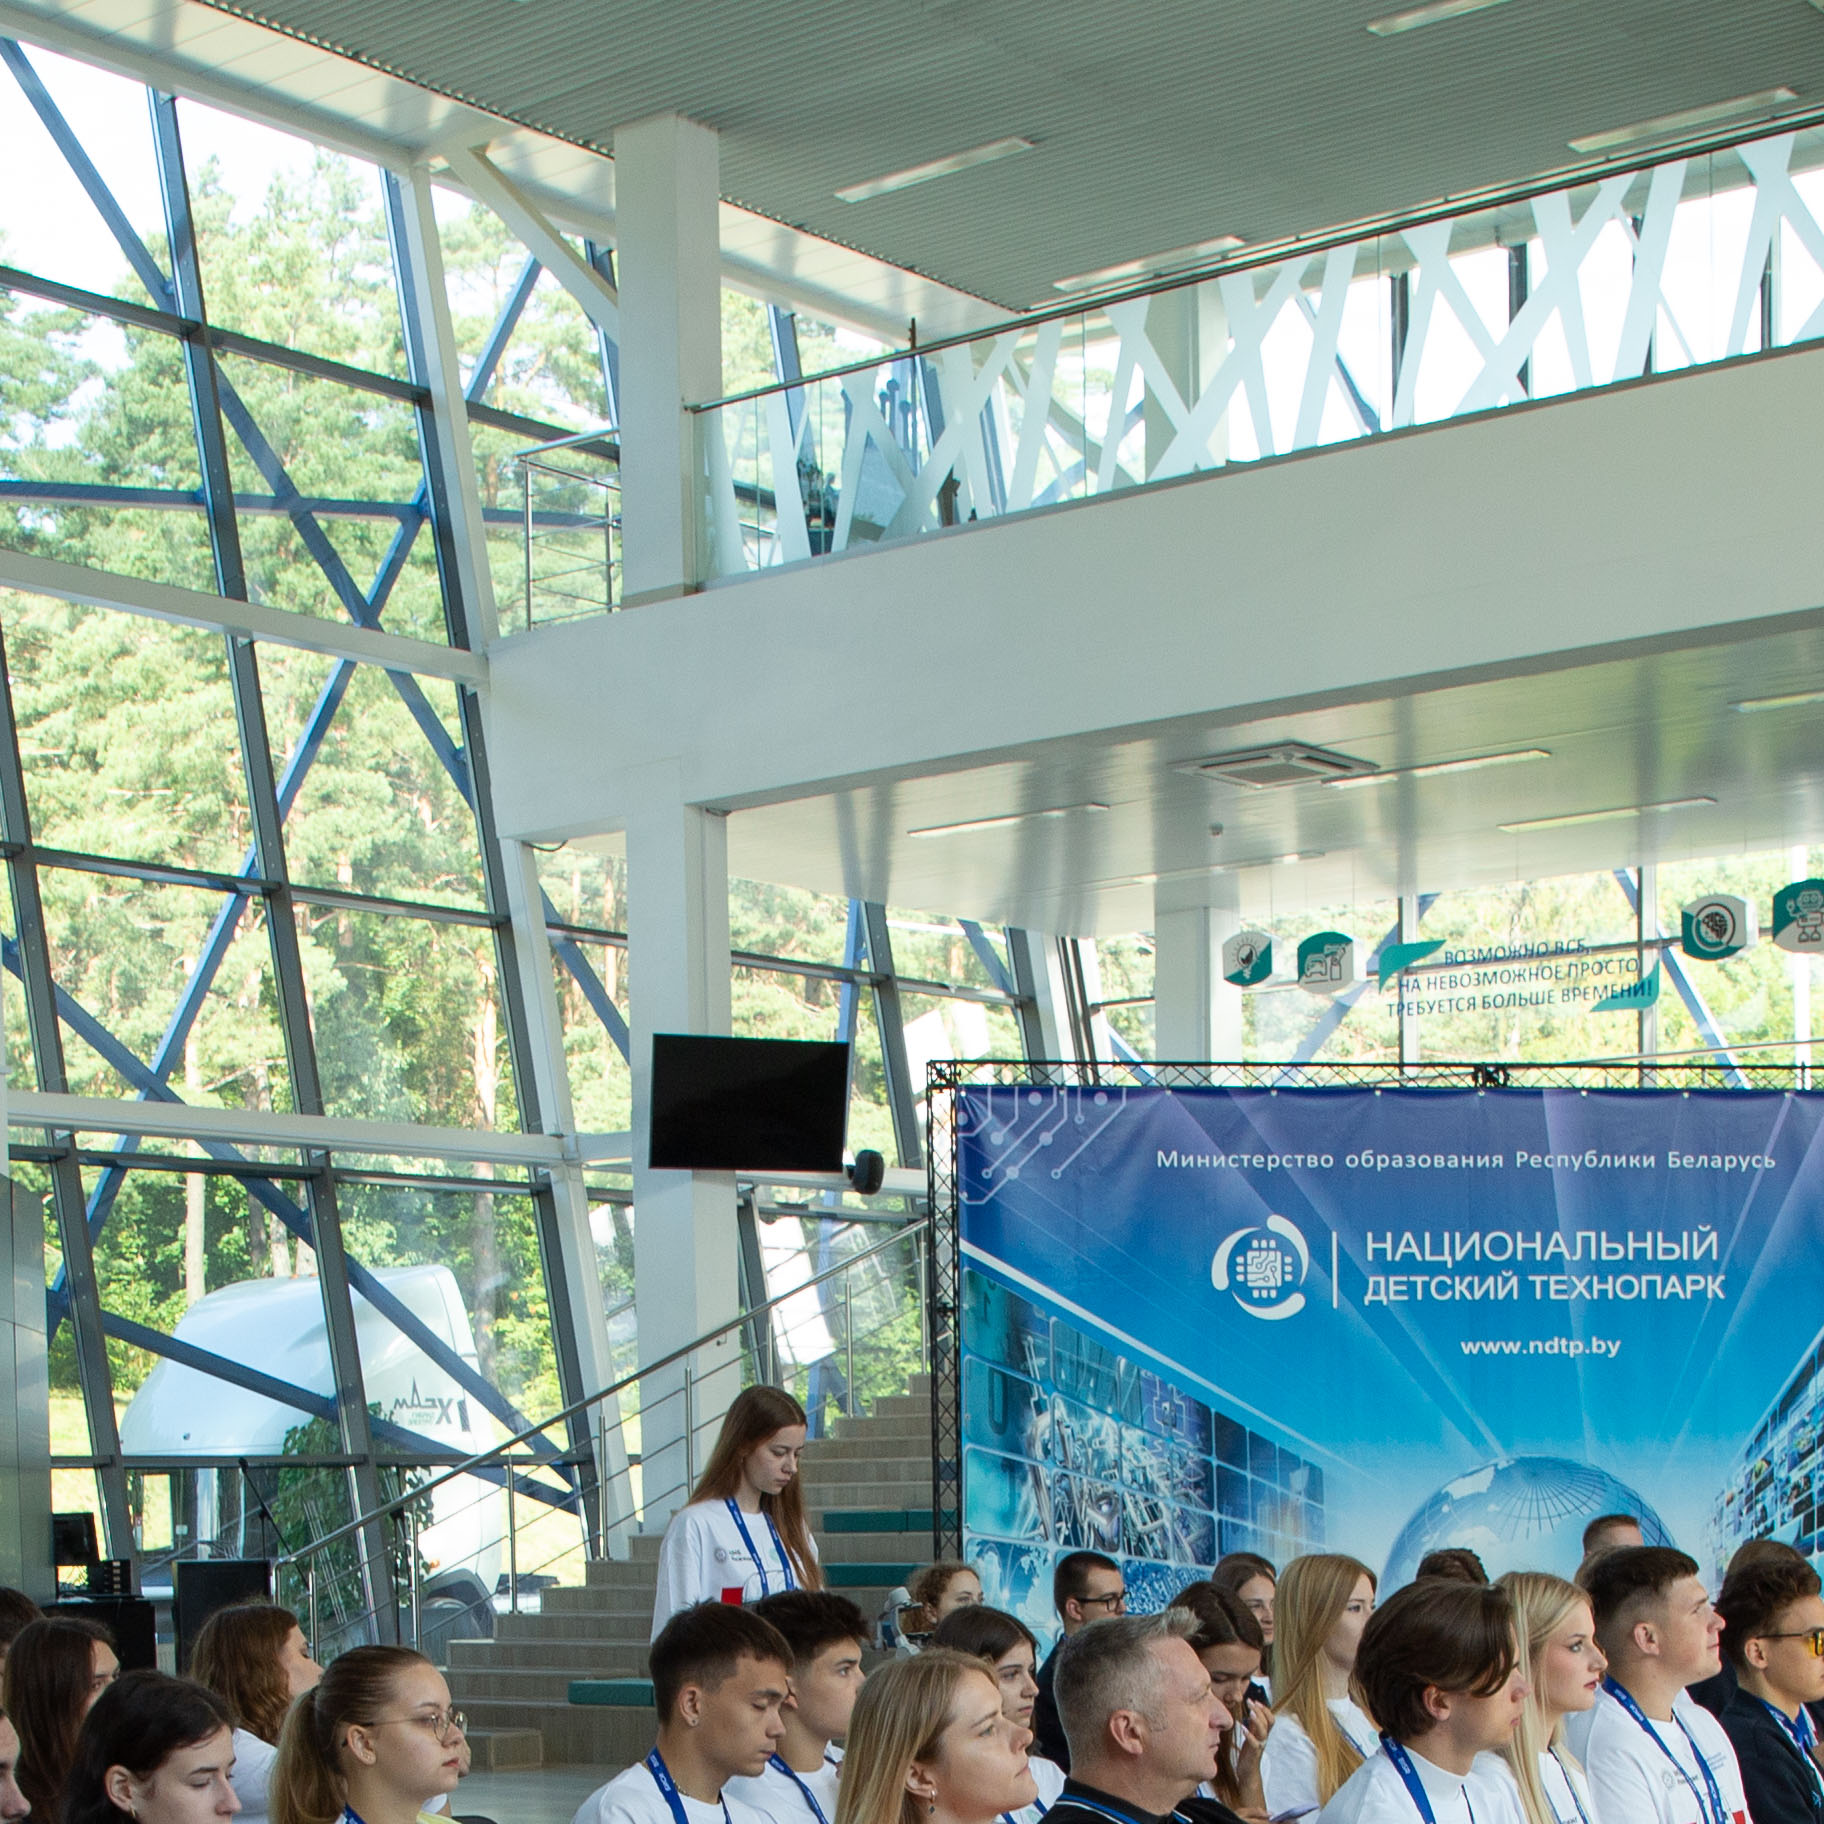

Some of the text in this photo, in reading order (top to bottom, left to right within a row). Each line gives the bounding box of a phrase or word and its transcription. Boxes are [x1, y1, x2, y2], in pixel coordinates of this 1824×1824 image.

[1444, 941, 1550, 966] ВОЗМОЖНО
[1399, 957, 1640, 994] НА НЕВОЗМОЖНОЕ ПРОСТО
[1386, 980, 1654, 1018] ТРЕБУЕТСЯ БОЛЬШЕ ВРЕМЕНИ!
[1156, 1149, 1776, 1172] Министерство образования Республики Беларусь
[1366, 1224, 1718, 1269] НАЦИОНАЛЬНЫЙ
[1364, 1269, 1726, 1306] ДЕТСКИЙ ТЕХНОПАРК
[1460, 1336, 1622, 1359] www.ndtp.by
